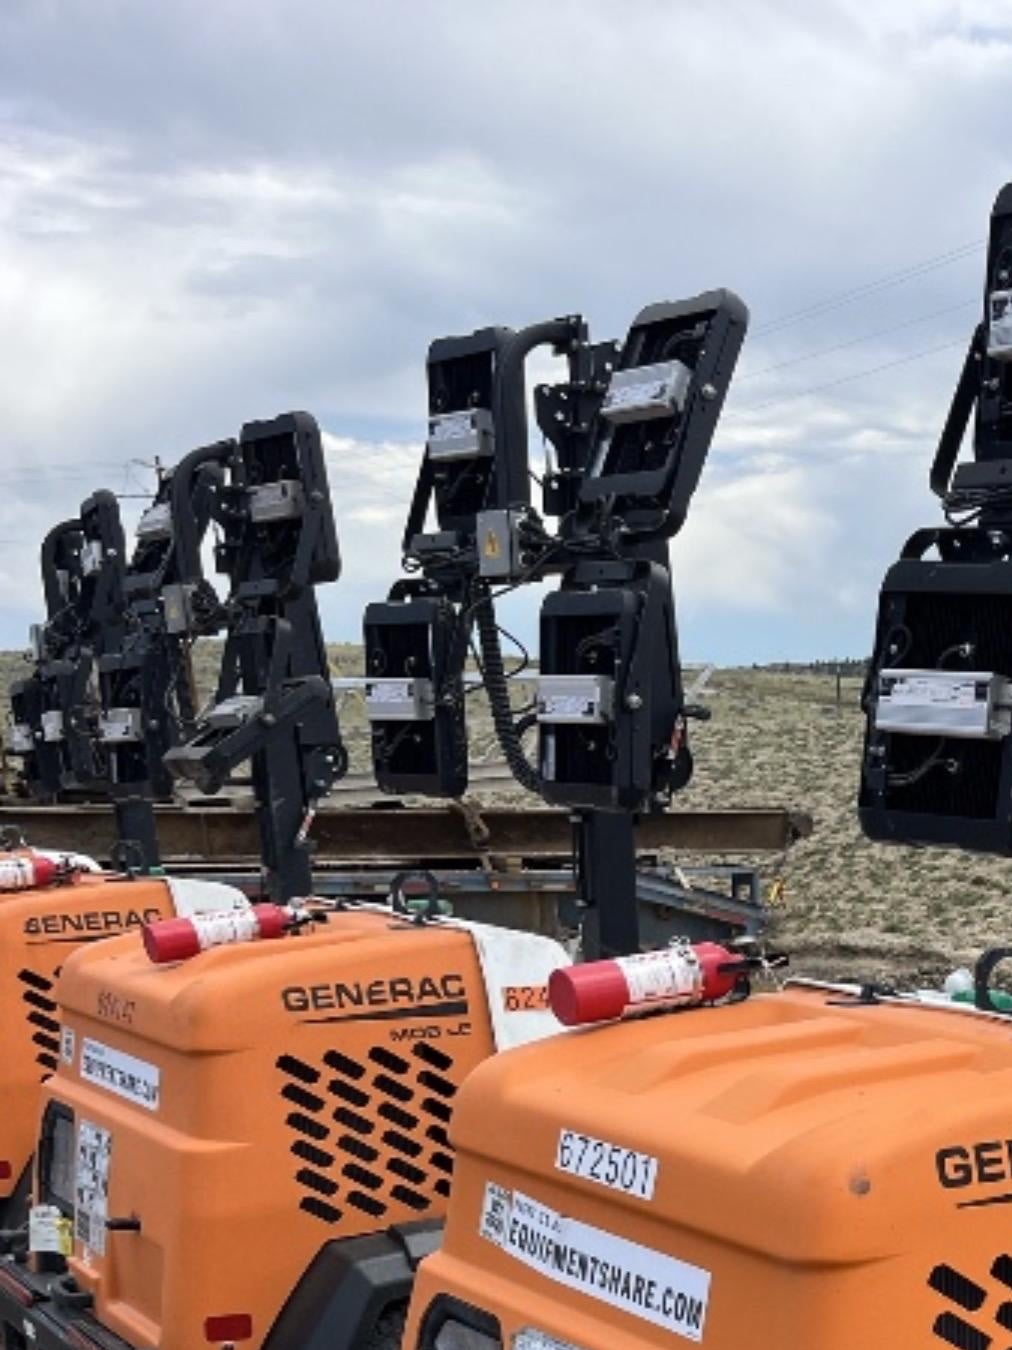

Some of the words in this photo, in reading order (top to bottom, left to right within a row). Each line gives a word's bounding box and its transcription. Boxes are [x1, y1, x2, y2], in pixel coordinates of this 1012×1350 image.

[24, 907, 163, 935] GENERAC
[281, 973, 466, 1012] GENERAC
[389, 1022, 472, 1042] MOBLE
[559, 1132, 652, 1195] 672501
[508, 1218, 703, 1330] EQUIPMENTSHARE.COM
